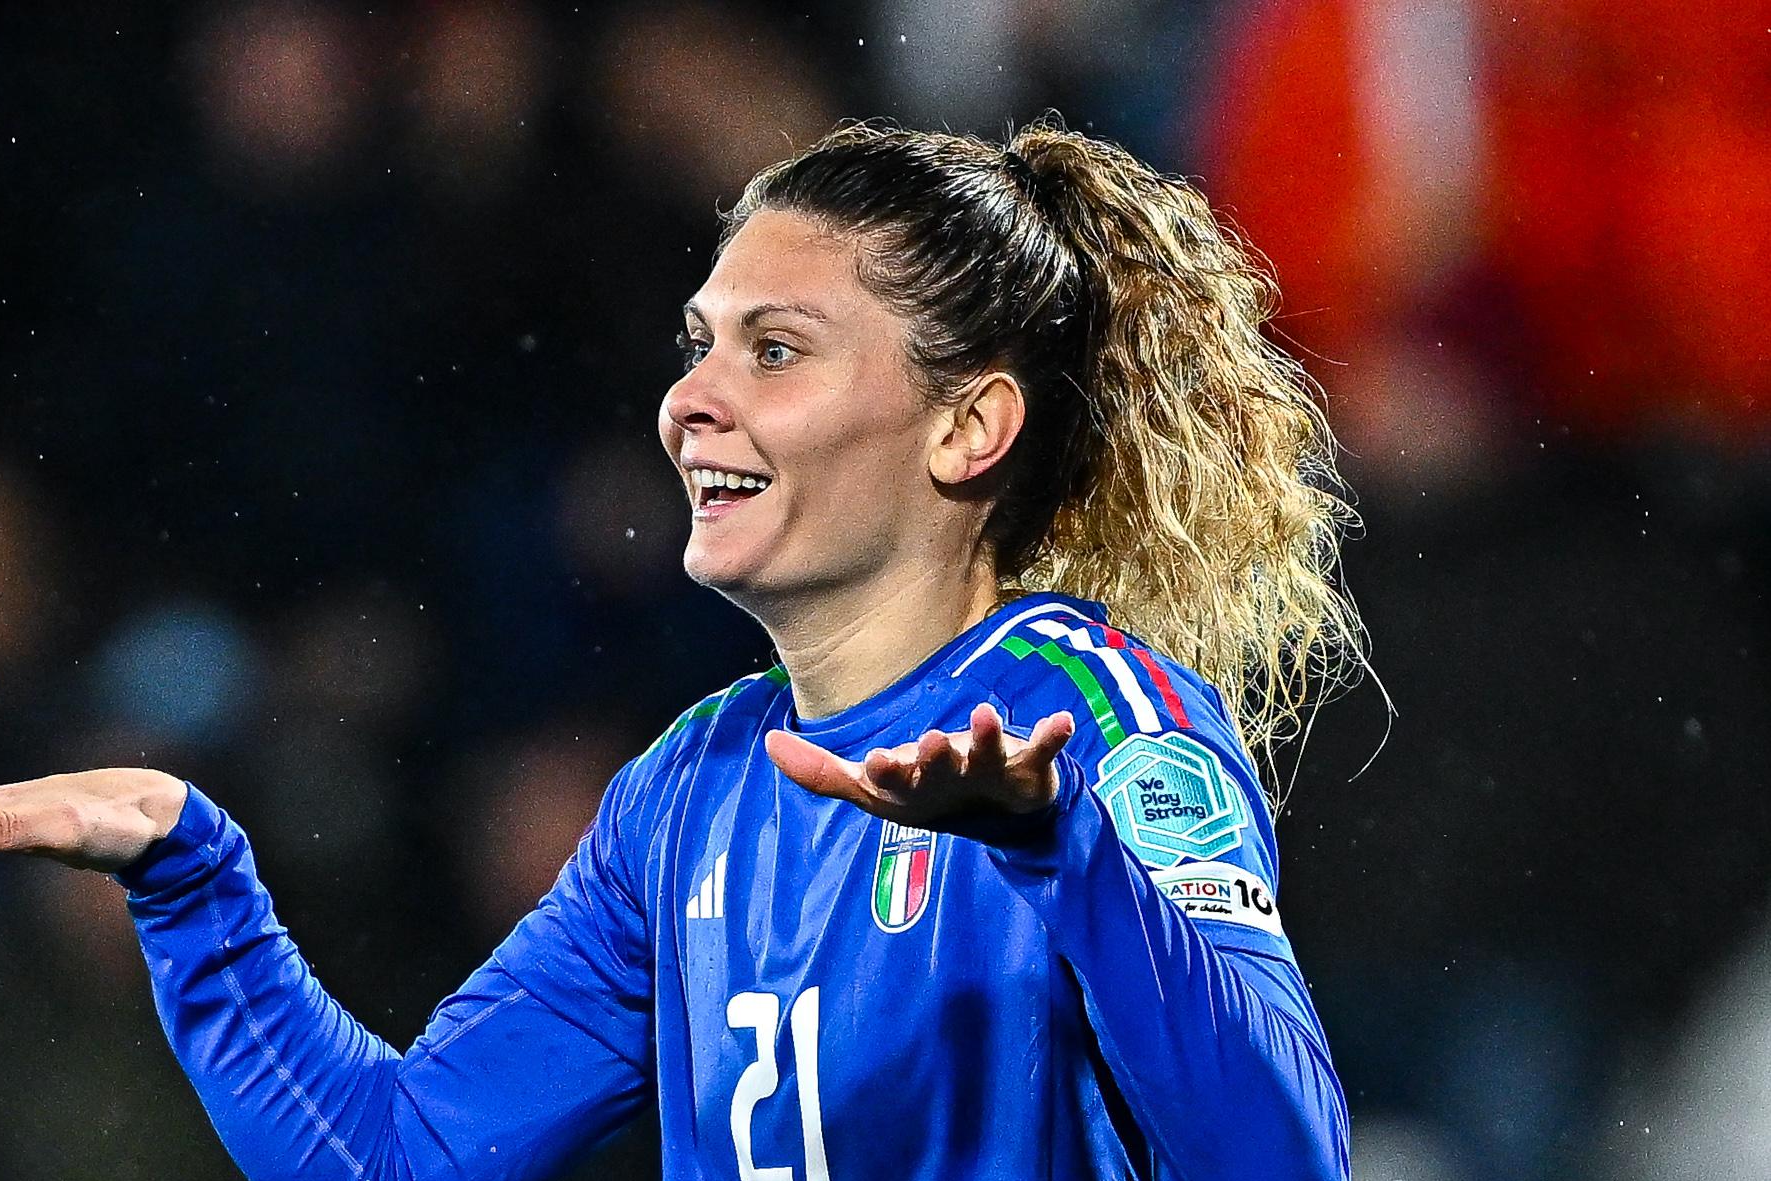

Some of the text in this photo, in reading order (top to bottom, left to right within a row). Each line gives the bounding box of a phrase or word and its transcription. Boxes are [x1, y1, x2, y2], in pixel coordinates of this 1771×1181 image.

[1135, 777, 1165, 792] We
[1140, 792, 1182, 808] Play
[1144, 805, 1206, 822] Strong
